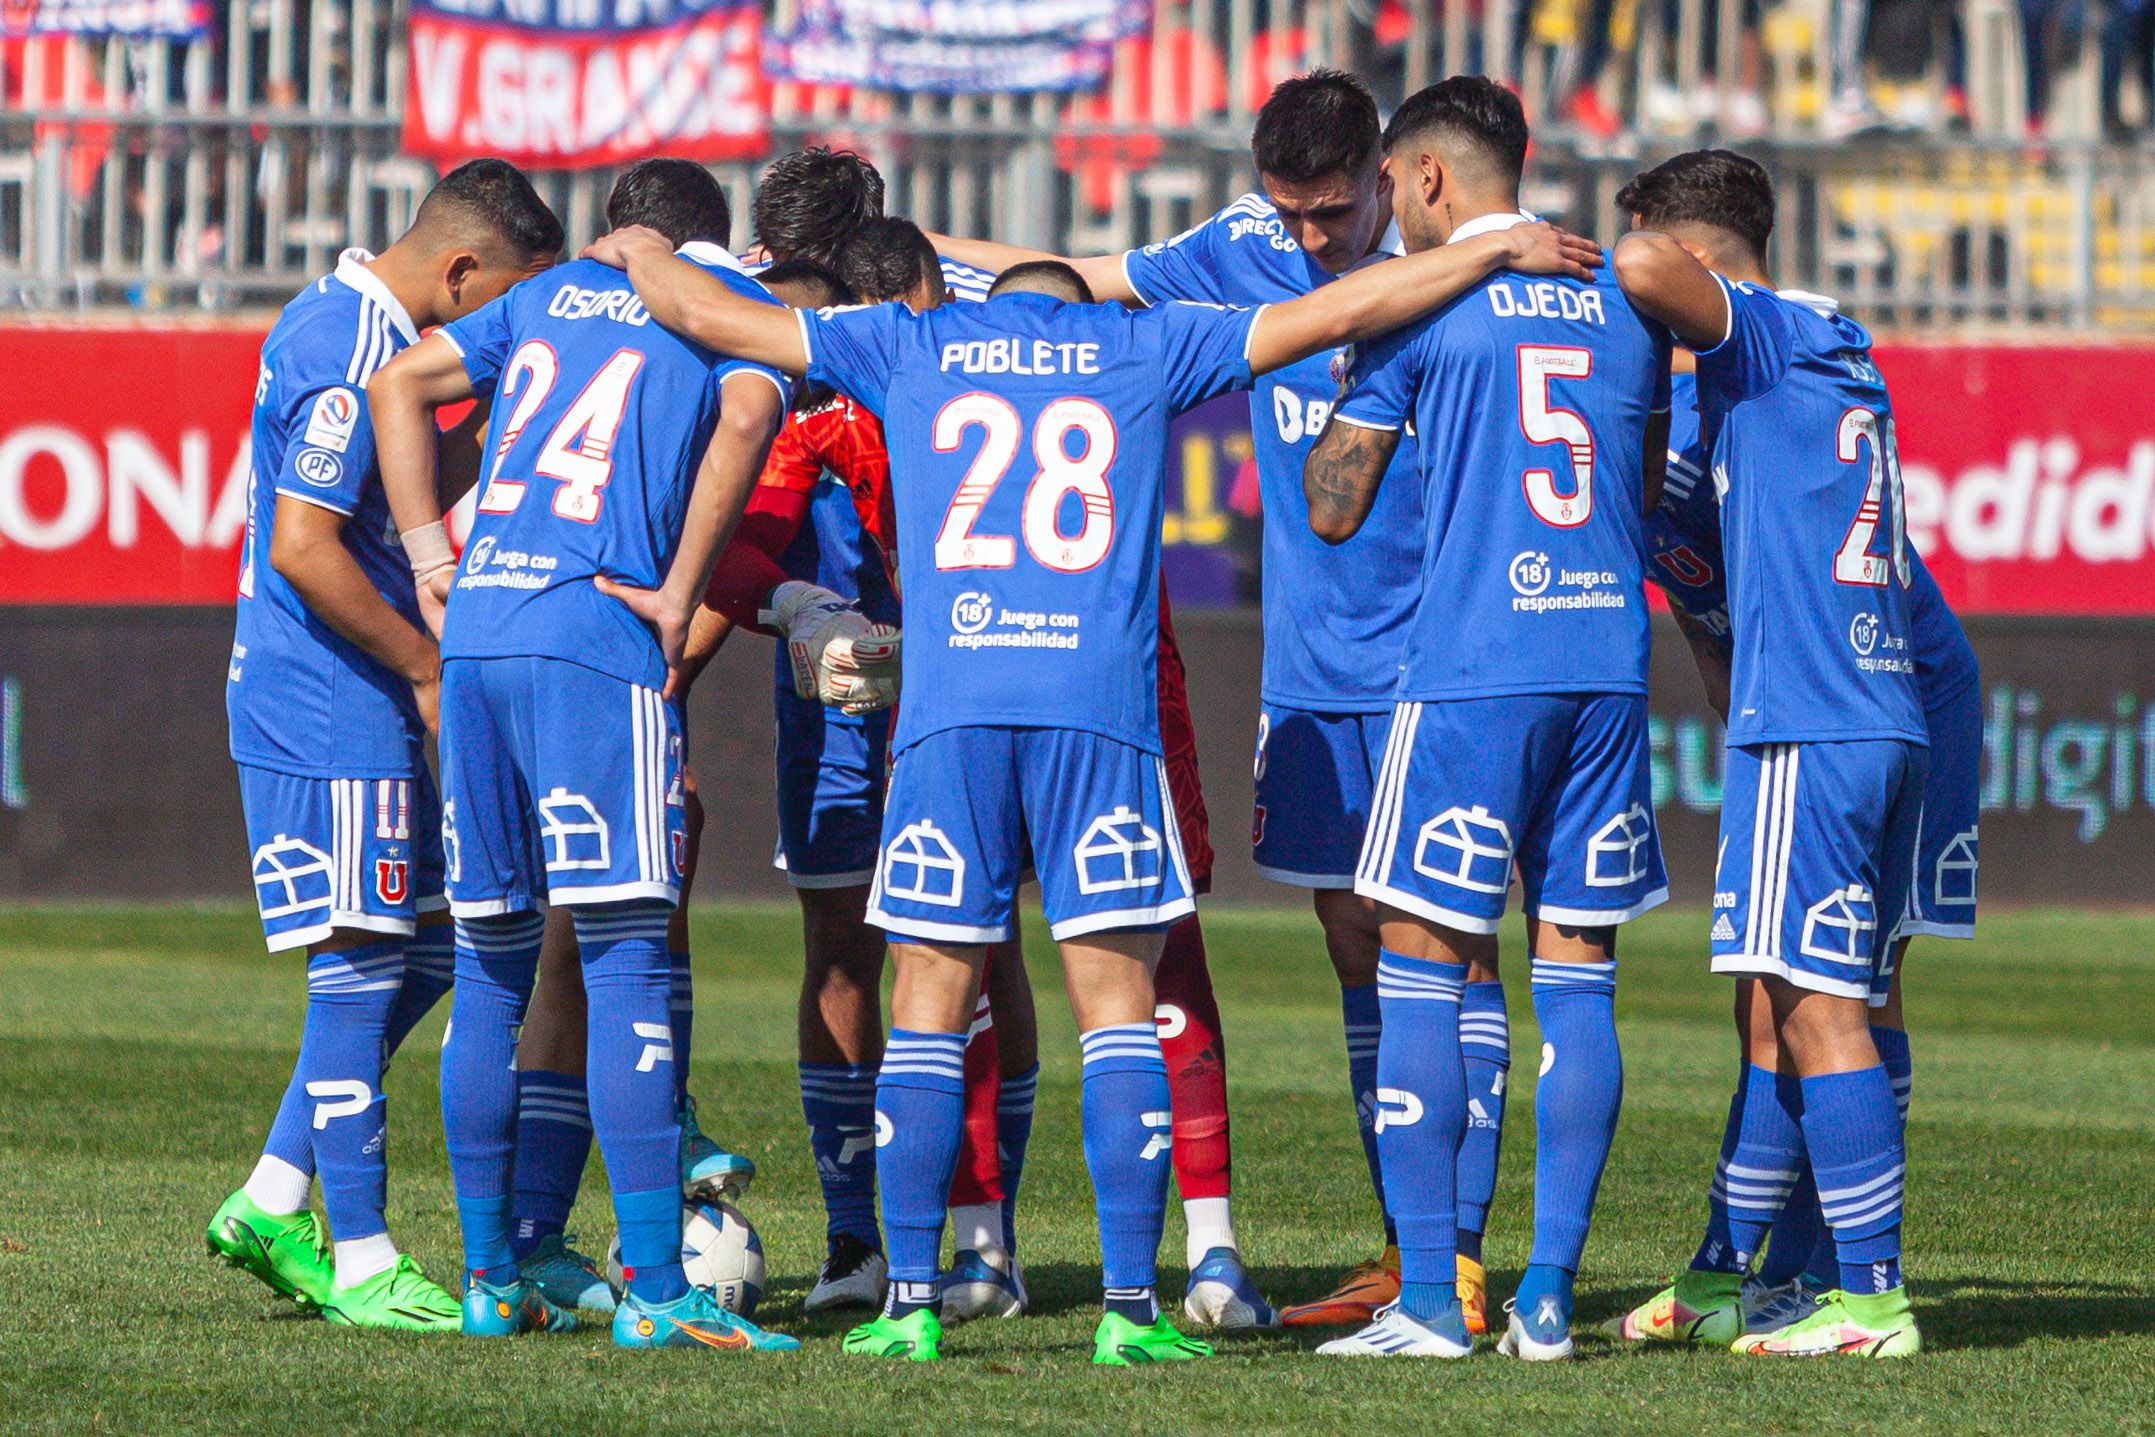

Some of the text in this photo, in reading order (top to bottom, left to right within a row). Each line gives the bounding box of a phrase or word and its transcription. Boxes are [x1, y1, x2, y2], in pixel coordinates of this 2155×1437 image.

[1487, 282, 1606, 325] OJEDA
[940, 338, 1100, 376] POBLETE
[478, 339, 645, 524] 24
[1515, 343, 1595, 530] 5
[306, 456, 333, 479] PF
[932, 390, 1118, 574] 28
[1557, 568, 1600, 589] Juega
[1512, 592, 1625, 615] responsabilidad
[997, 608, 1046, 630] Juega
[1048, 614, 1080, 629] con
[948, 630, 1079, 651] responsabilidad
